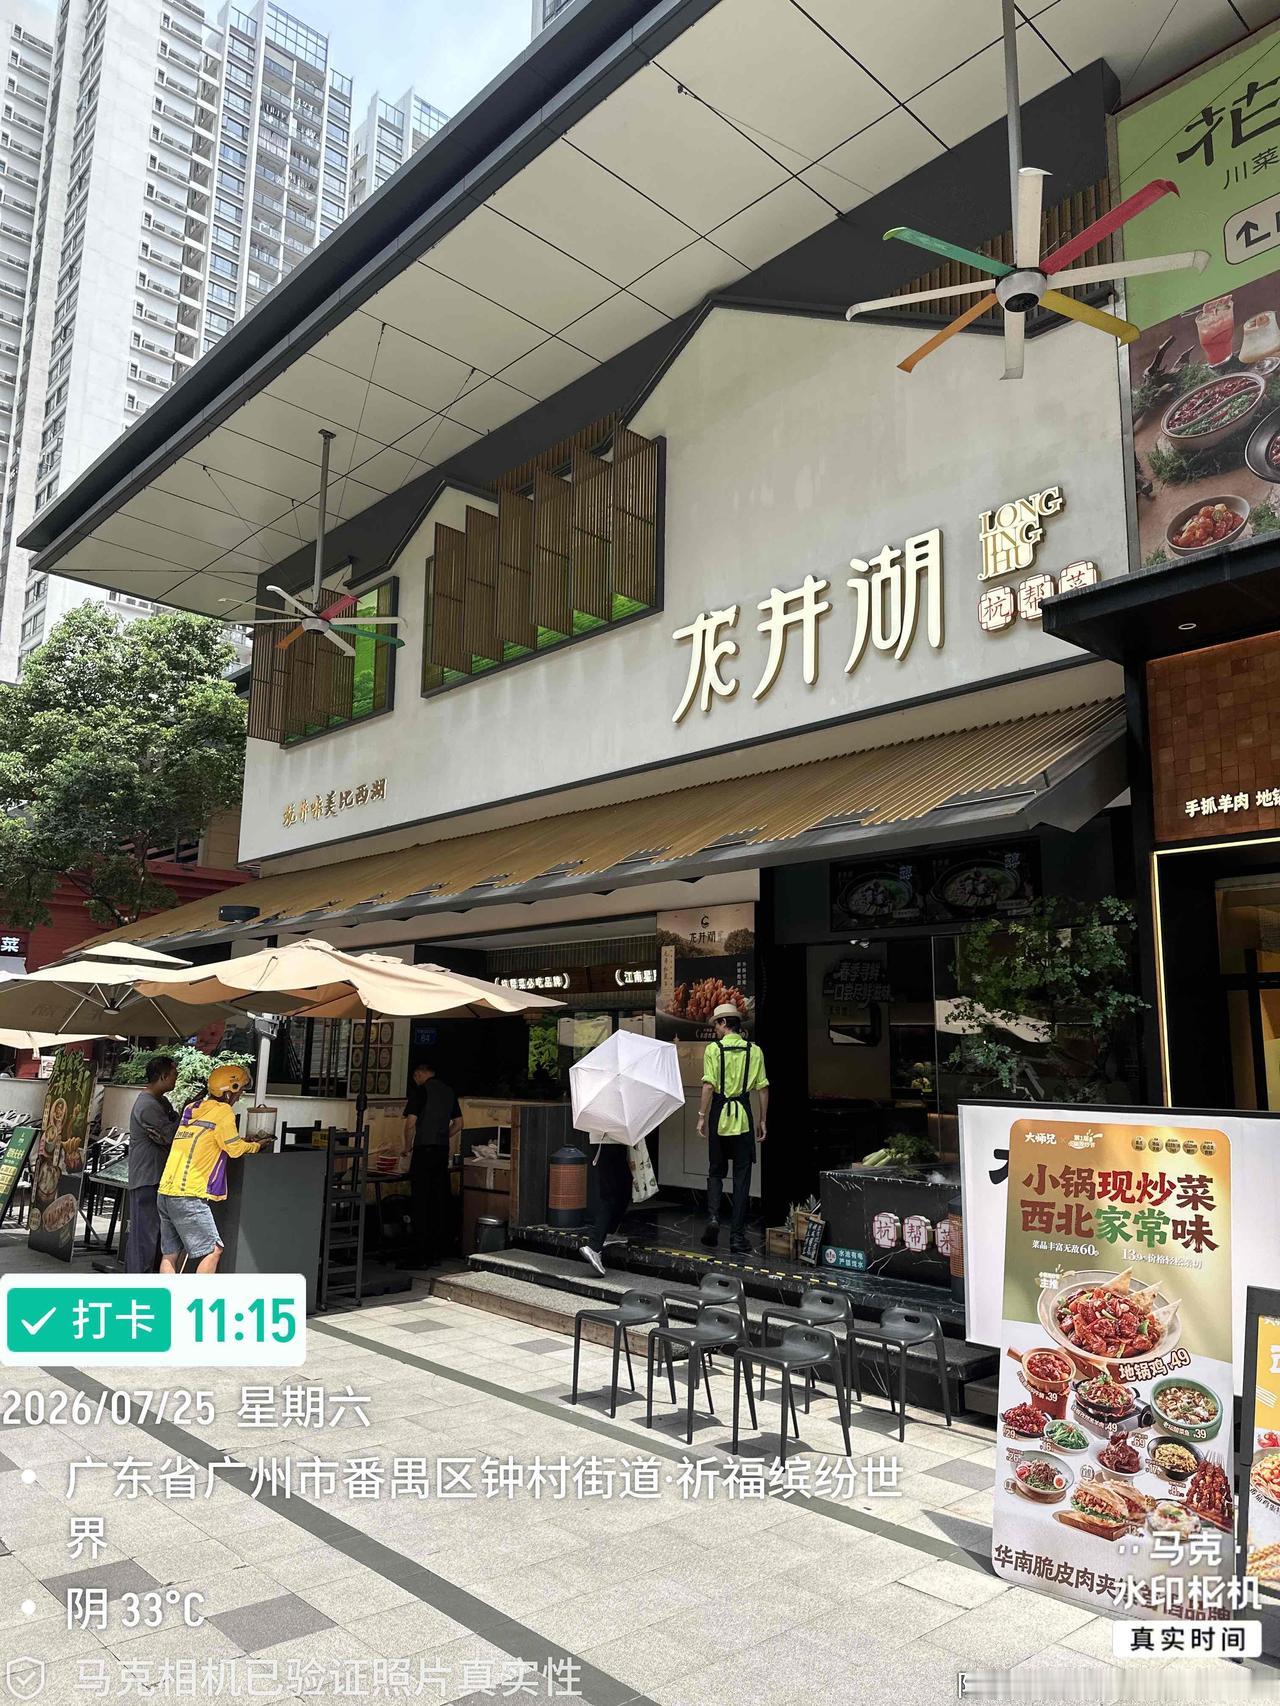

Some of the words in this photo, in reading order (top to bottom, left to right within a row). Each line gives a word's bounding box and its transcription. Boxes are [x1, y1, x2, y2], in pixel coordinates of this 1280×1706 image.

[1224, 146, 1279, 189] 川菜
[979, 487, 1062, 536] LONG
[672, 528, 943, 723] 龙井湖
[1185, 792, 1250, 818] 手抓羊肉
[1022, 1164, 1217, 1211] 小锅现炒菜
[1020, 1199, 1221, 1253] 西北家常味
[1118, 1358, 1168, 1384] 地锅鸡
